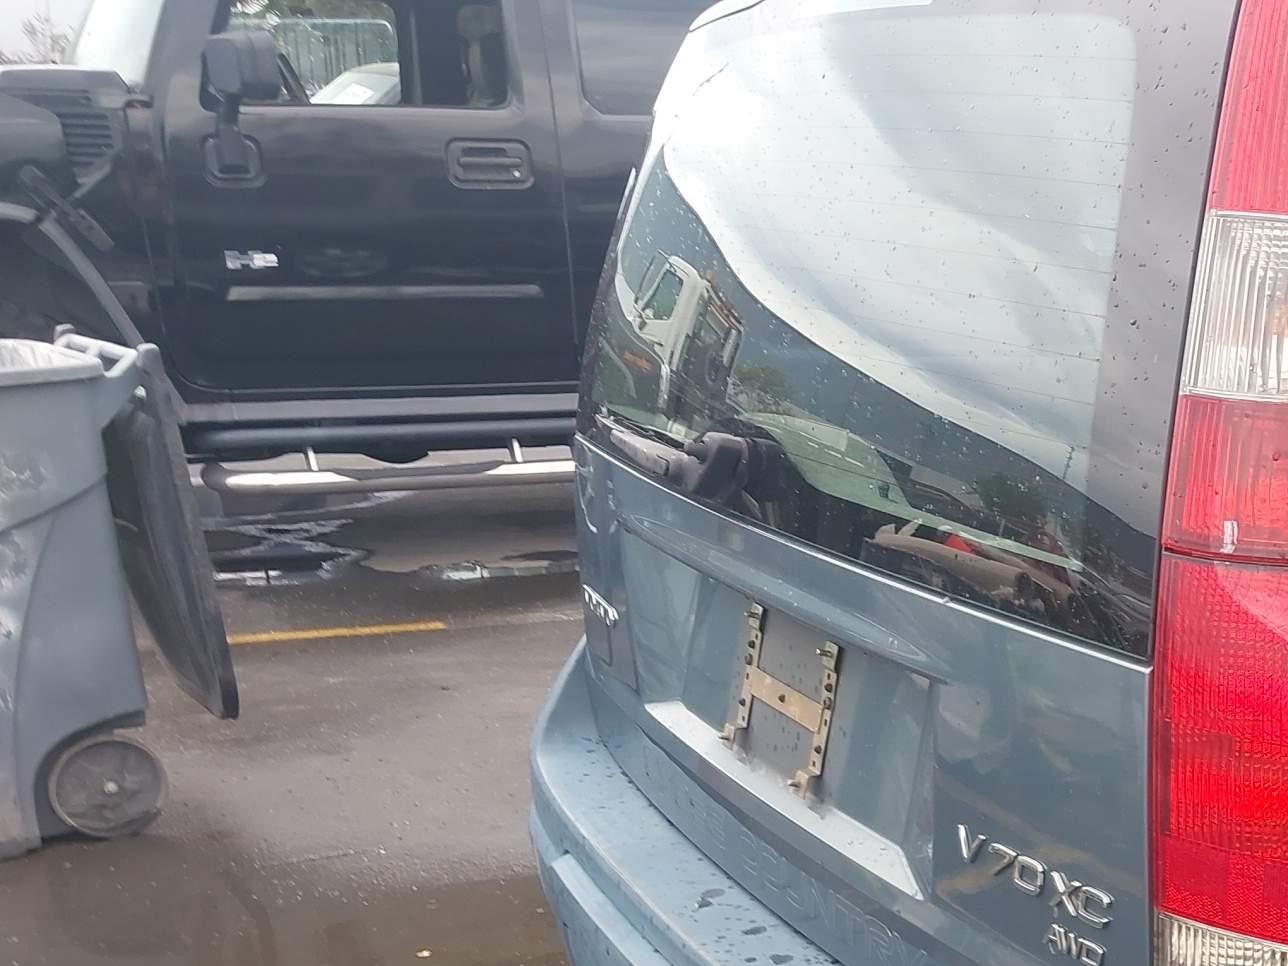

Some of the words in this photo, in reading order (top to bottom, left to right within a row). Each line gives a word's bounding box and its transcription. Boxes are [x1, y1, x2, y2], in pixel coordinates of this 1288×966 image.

[224, 249, 280, 271] H2
[957, 824, 1048, 896] V70
[1048, 871, 1115, 928] XC
